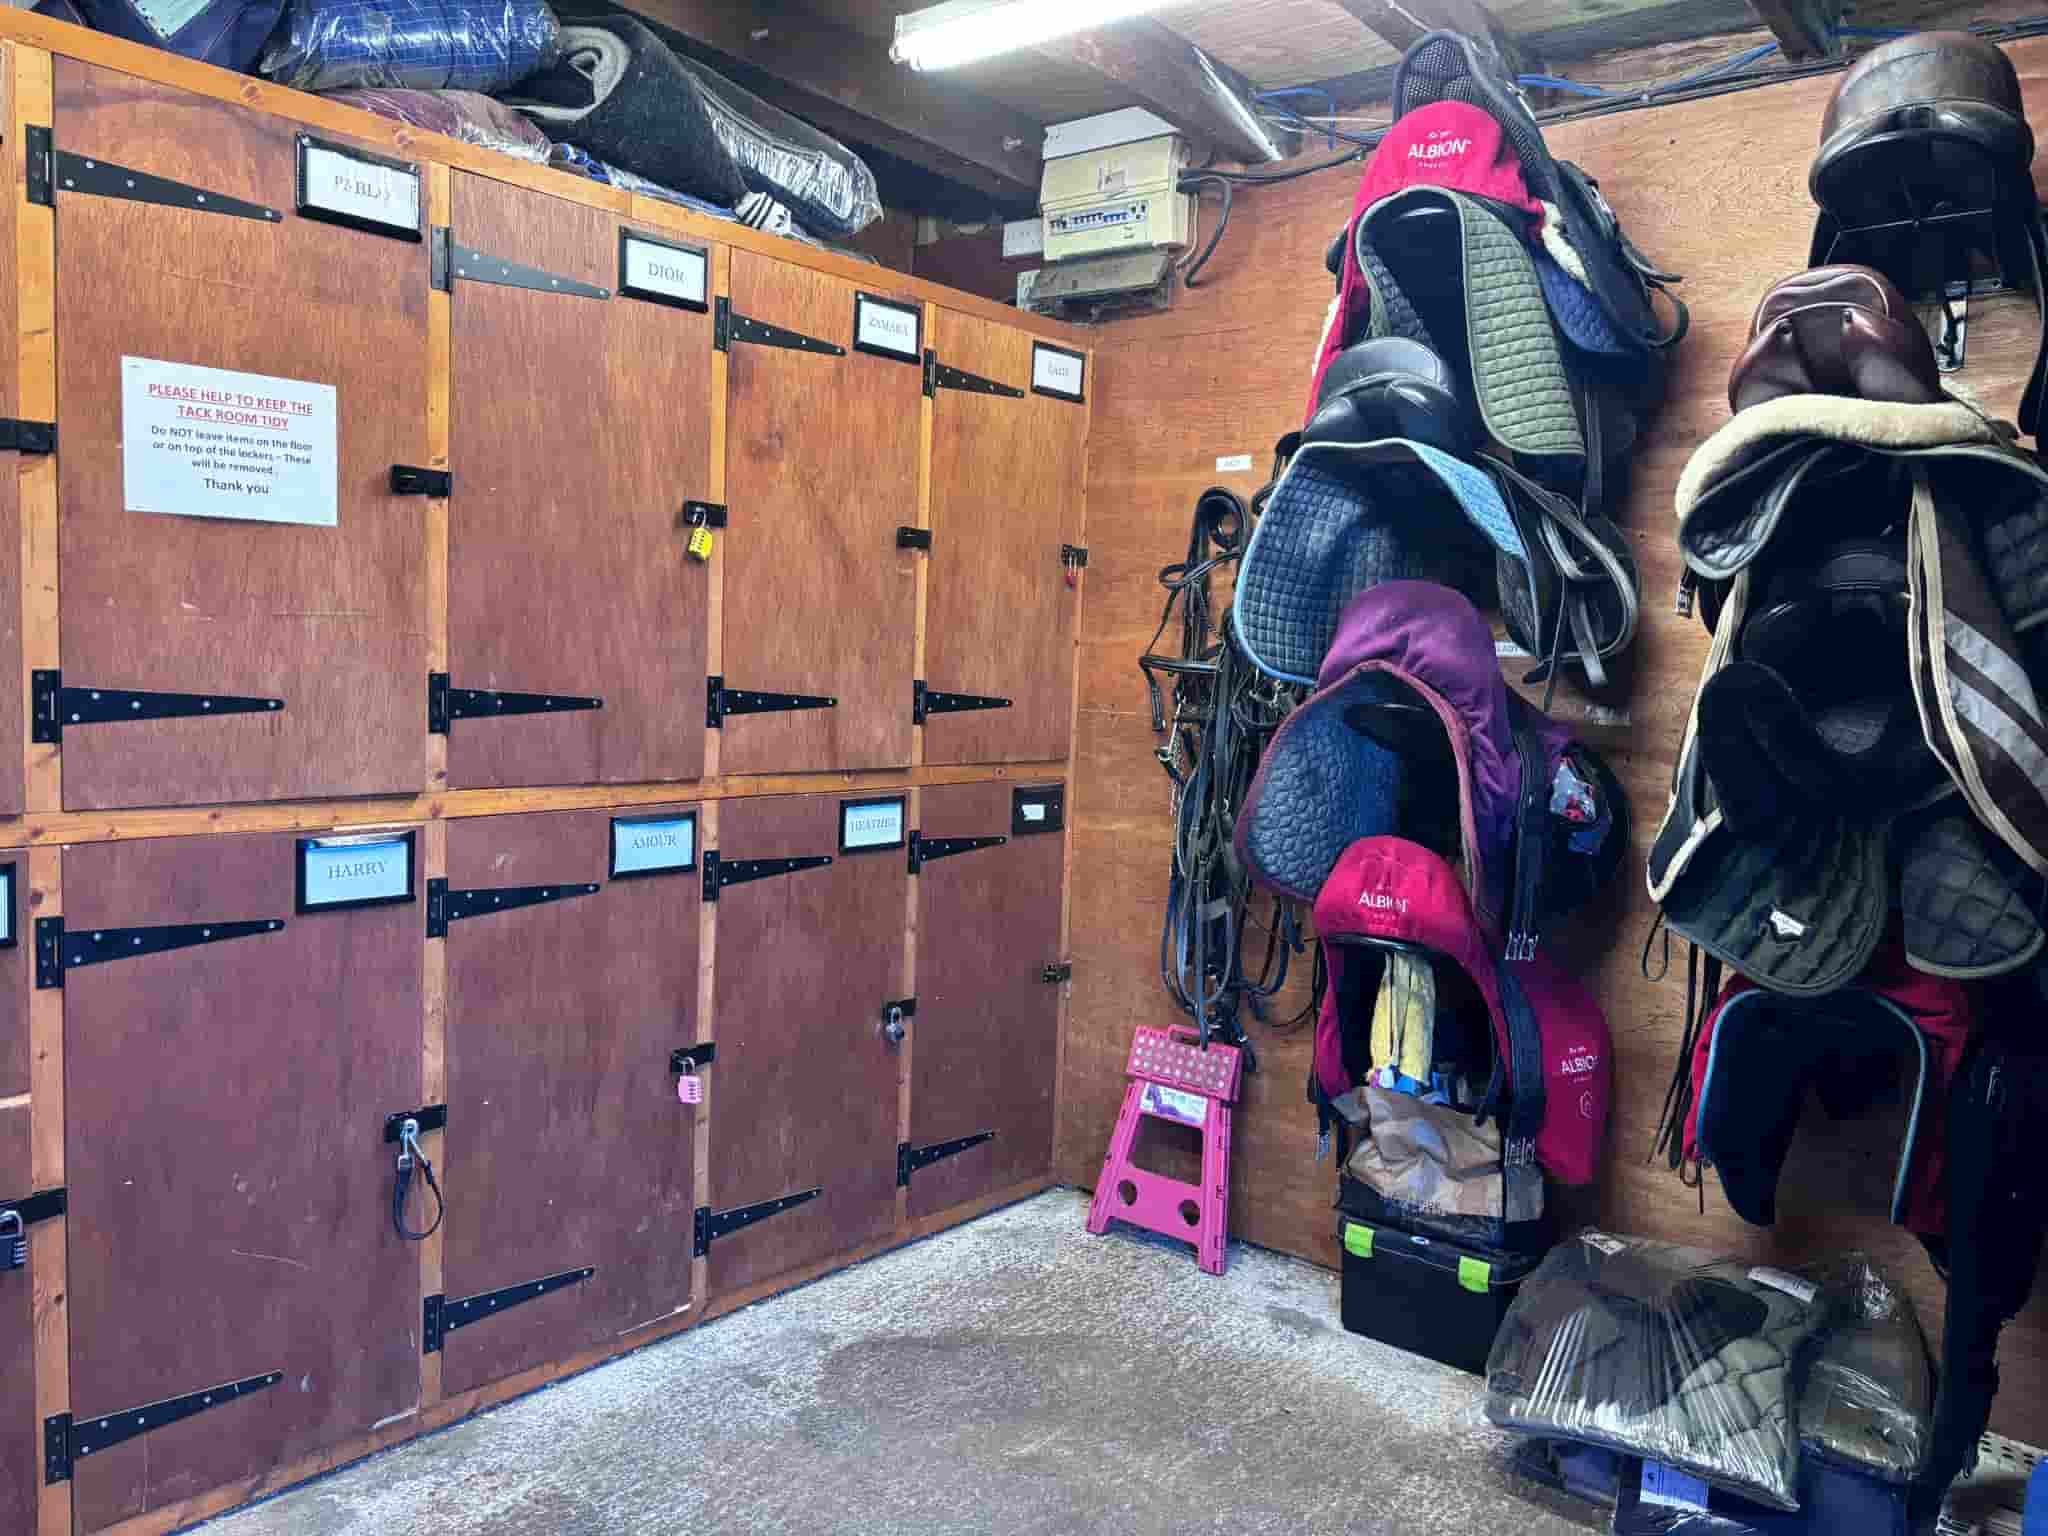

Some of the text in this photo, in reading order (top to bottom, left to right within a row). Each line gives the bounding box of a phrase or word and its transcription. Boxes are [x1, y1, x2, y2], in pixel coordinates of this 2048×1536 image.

[1408, 138, 1470, 159] ALBION
[648, 262, 688, 285] DIOR
[149, 383, 313, 415] PLEASE HELP TO KEEP THE
[178, 404, 289, 428] TACK ROOM TIDY
[151, 425, 167, 435] Do
[170, 427, 193, 438] NOT
[196, 428, 223, 441] leave
[226, 432, 254, 445] items
[257, 438, 269, 447] on
[272, 439, 288, 449] the
[152, 441, 165, 449] or
[168, 442, 182, 452] on
[184, 443, 202, 455] top
[206, 445, 216, 454] of
[219, 447, 236, 456] the
[238, 448, 273, 461] lockers
[284, 453, 312, 464] These
[192, 458, 210, 469] will
[213, 460, 225, 470] be
[204, 478, 270, 496] Thank you
[631, 830, 679, 849] AMOUR
[327, 860, 388, 880] HARRY
